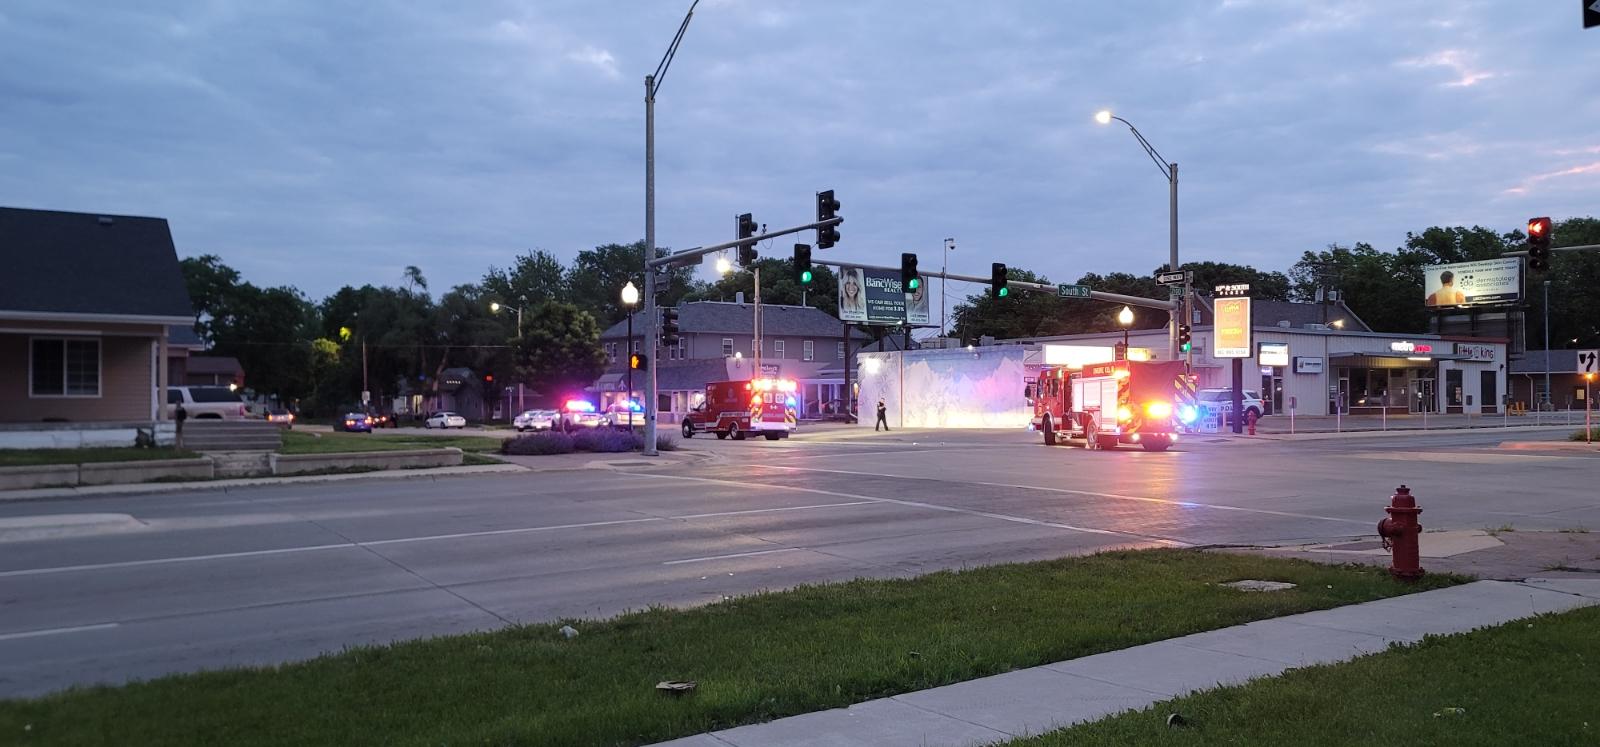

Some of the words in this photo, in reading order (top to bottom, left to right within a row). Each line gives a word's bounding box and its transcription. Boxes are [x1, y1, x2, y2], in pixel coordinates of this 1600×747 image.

[866, 277, 902, 289] BancWise
[1061, 285, 1079, 296] South
[1081, 288, 1089, 297] St
[1391, 341, 1414, 352] metro
[1480, 346, 1494, 359] king
